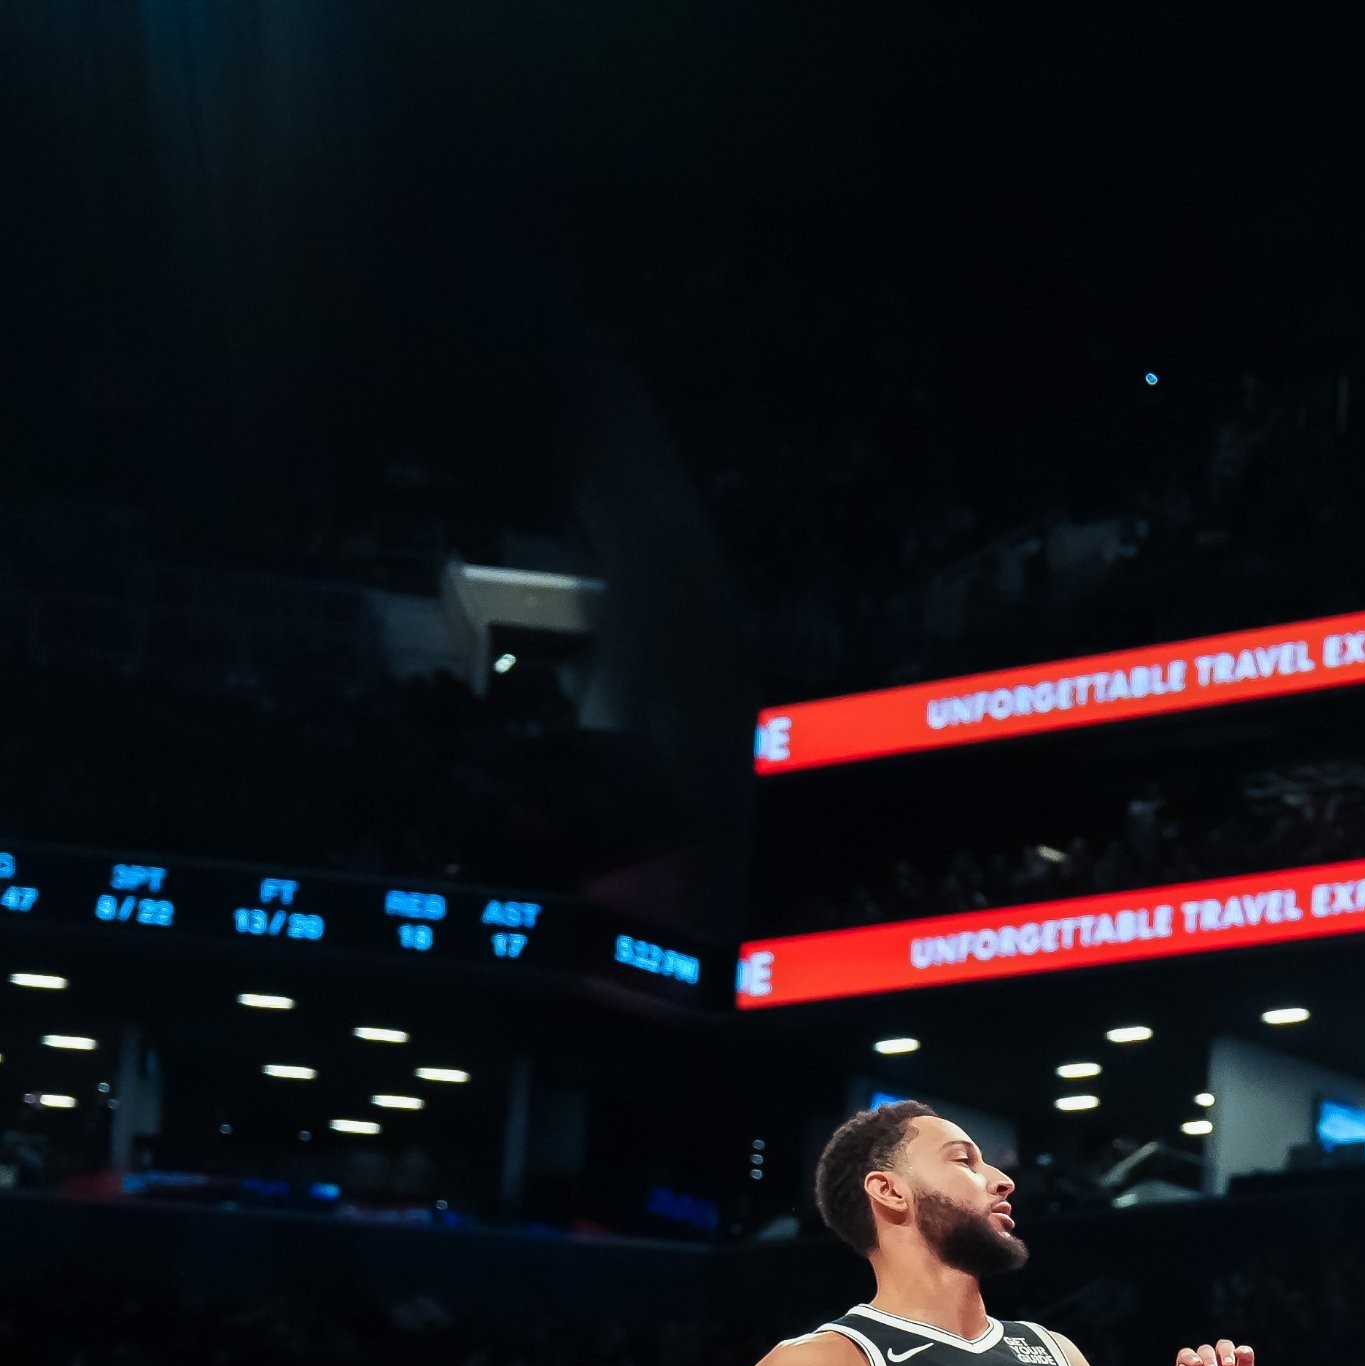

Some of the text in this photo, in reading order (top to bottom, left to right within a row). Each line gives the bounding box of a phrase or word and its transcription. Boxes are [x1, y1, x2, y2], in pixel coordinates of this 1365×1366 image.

[927, 660, 1187, 729] UNFORGETTABLE
[1195, 641, 1315, 686] TRAVEL
[910, 905, 1173, 969] UNFORGETTABLE
[1182, 889, 1303, 934] TRAVEL
[1003, 1336, 1026, 1346] GET
[1012, 1345, 1048, 1356] YOUR
[1016, 1354, 1057, 1366] GUIDE
